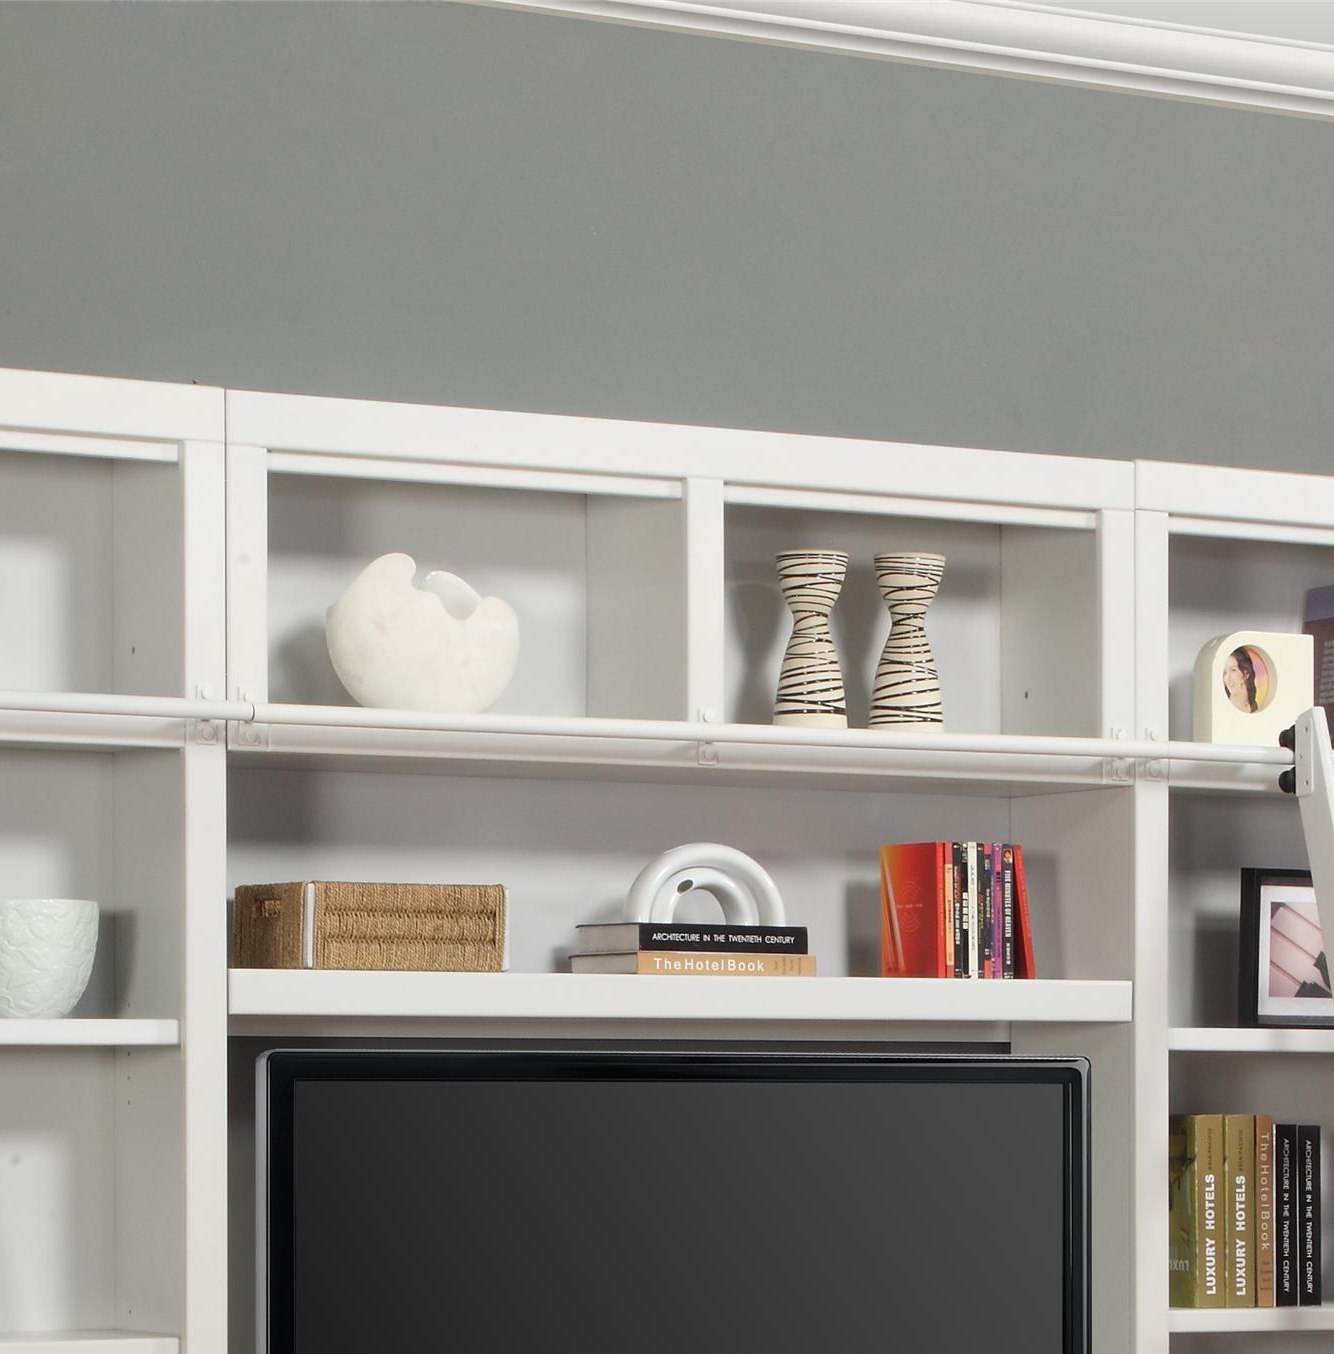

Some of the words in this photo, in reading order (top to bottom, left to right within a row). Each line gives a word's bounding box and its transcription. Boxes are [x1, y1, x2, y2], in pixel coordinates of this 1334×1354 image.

[652, 933, 700, 942] ARCHITECTURE
[703, 934, 711, 942] IN
[714, 934, 725, 942] THE
[728, 935, 762, 943] TWENTIETH
[765, 935, 795, 944] CENTURY
[1282, 1138, 1290, 1190] ARCHITECTURE
[1305, 1139, 1313, 1191] ARCHITECTURE
[1205, 1174, 1215, 1230] HOTELS
[1236, 1175, 1246, 1231] HOTELS
[1283, 1193, 1289, 1201] IN
[1306, 1194, 1312, 1203] IN
[1205, 1238, 1216, 1295] LUXURY
[1236, 1239, 1246, 1296] LUXURY
